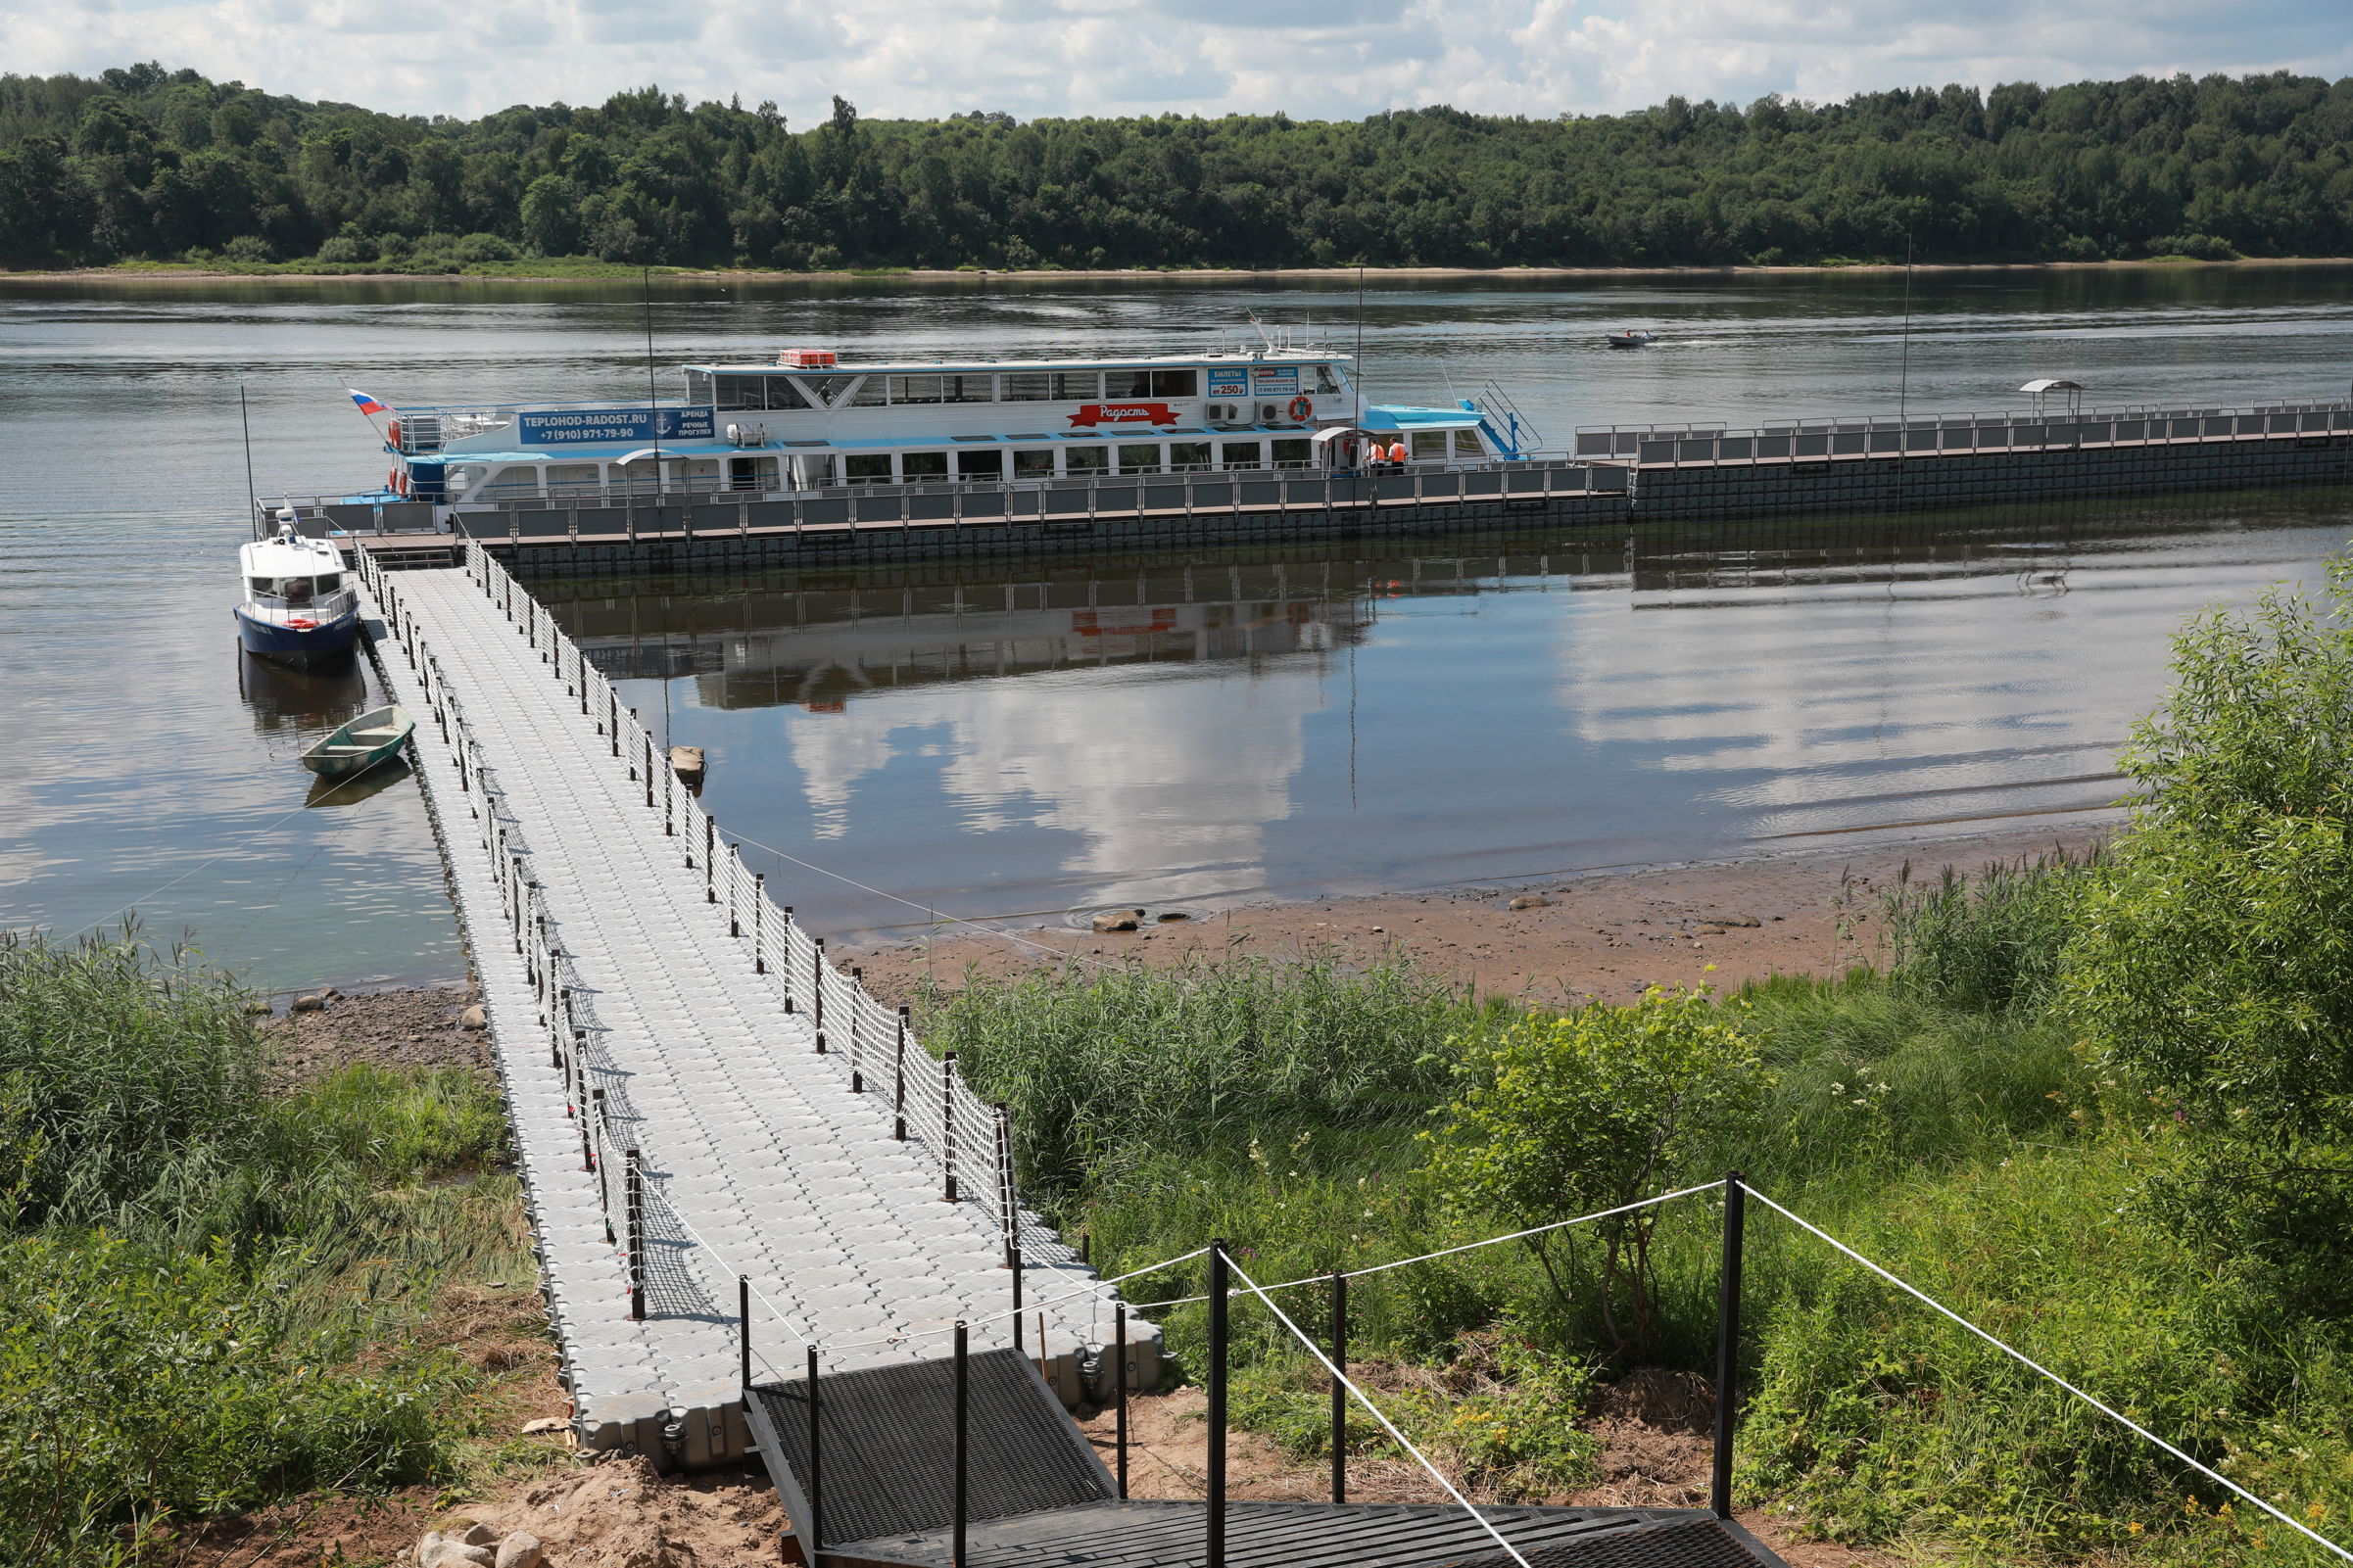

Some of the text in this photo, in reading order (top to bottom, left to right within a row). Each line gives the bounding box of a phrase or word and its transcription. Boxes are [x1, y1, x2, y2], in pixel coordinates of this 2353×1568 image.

[1221, 385, 1239, 395] 250
[1099, 405, 1149, 421] Радость
[524, 414, 647, 427] TEPLOHOD-RADOST.RU
[540, 428, 634, 440] +7 (910) 971-79-90
